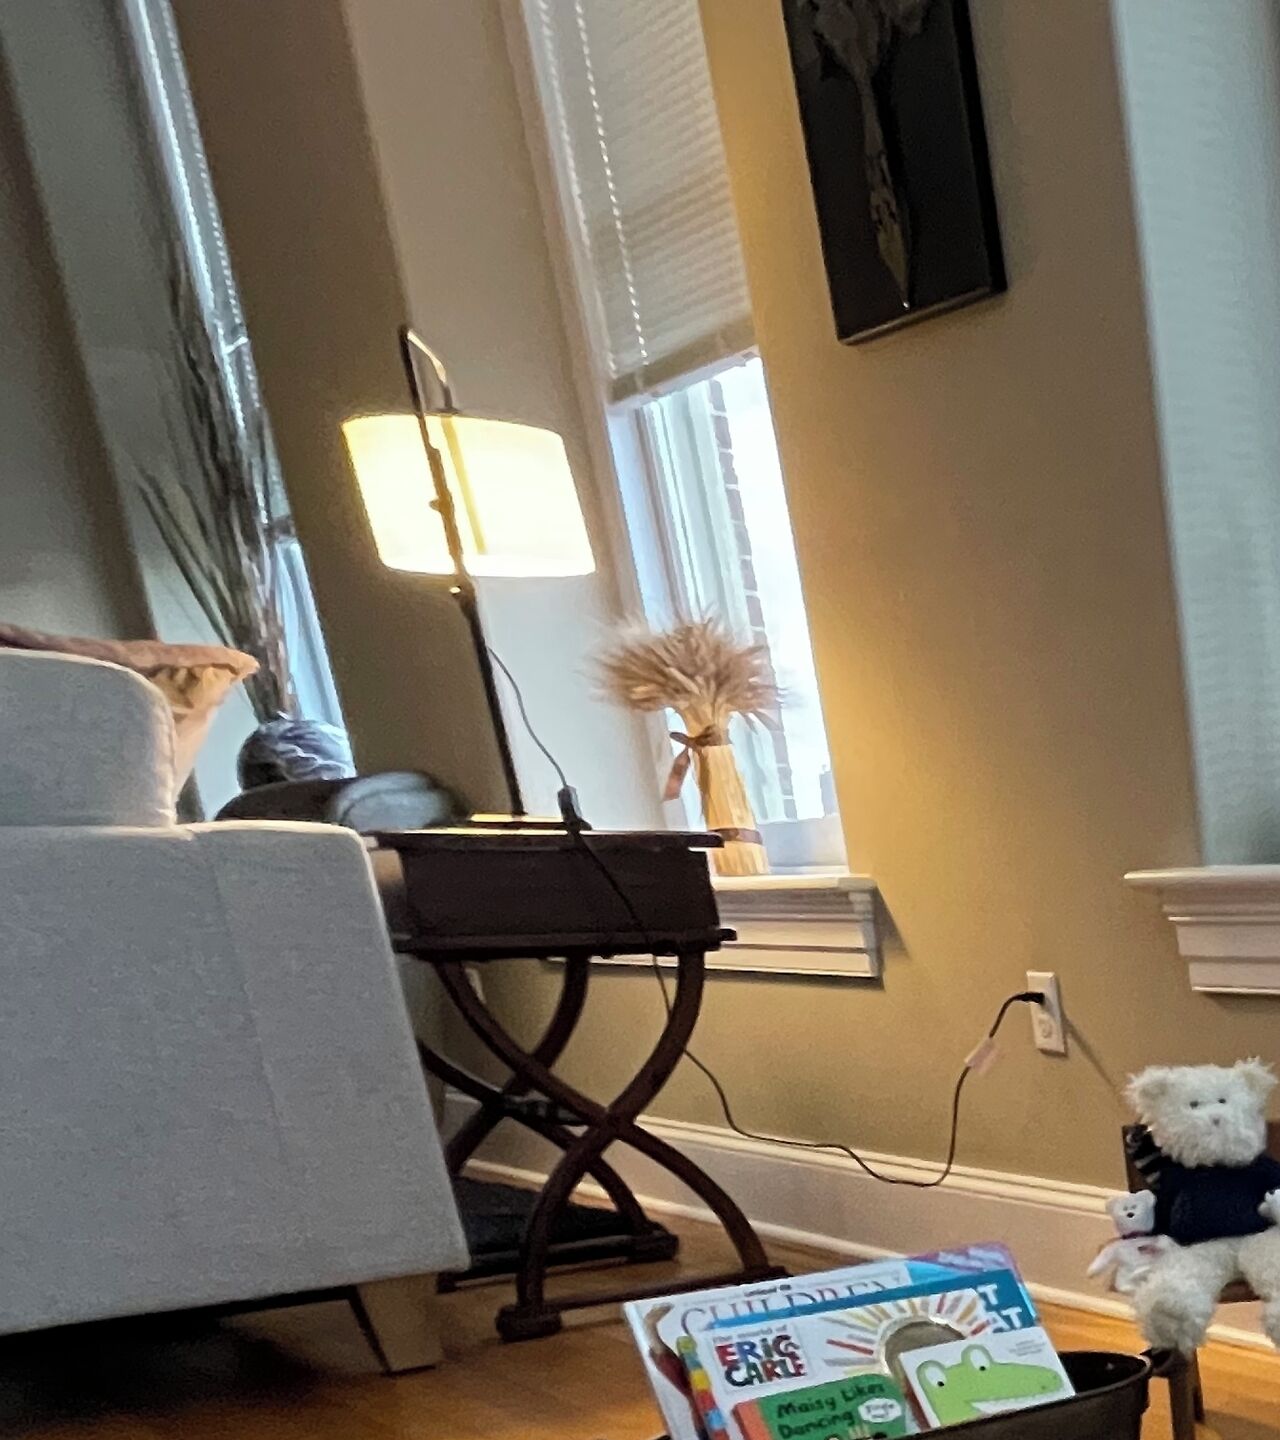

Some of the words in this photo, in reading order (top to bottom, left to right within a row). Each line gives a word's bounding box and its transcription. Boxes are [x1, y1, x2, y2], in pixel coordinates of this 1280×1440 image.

[724, 1358, 807, 1387] CARLE
[777, 1397, 837, 1419] Maisy
[841, 1383, 885, 1402] Likes
[777, 1411, 855, 1439] Dancing
